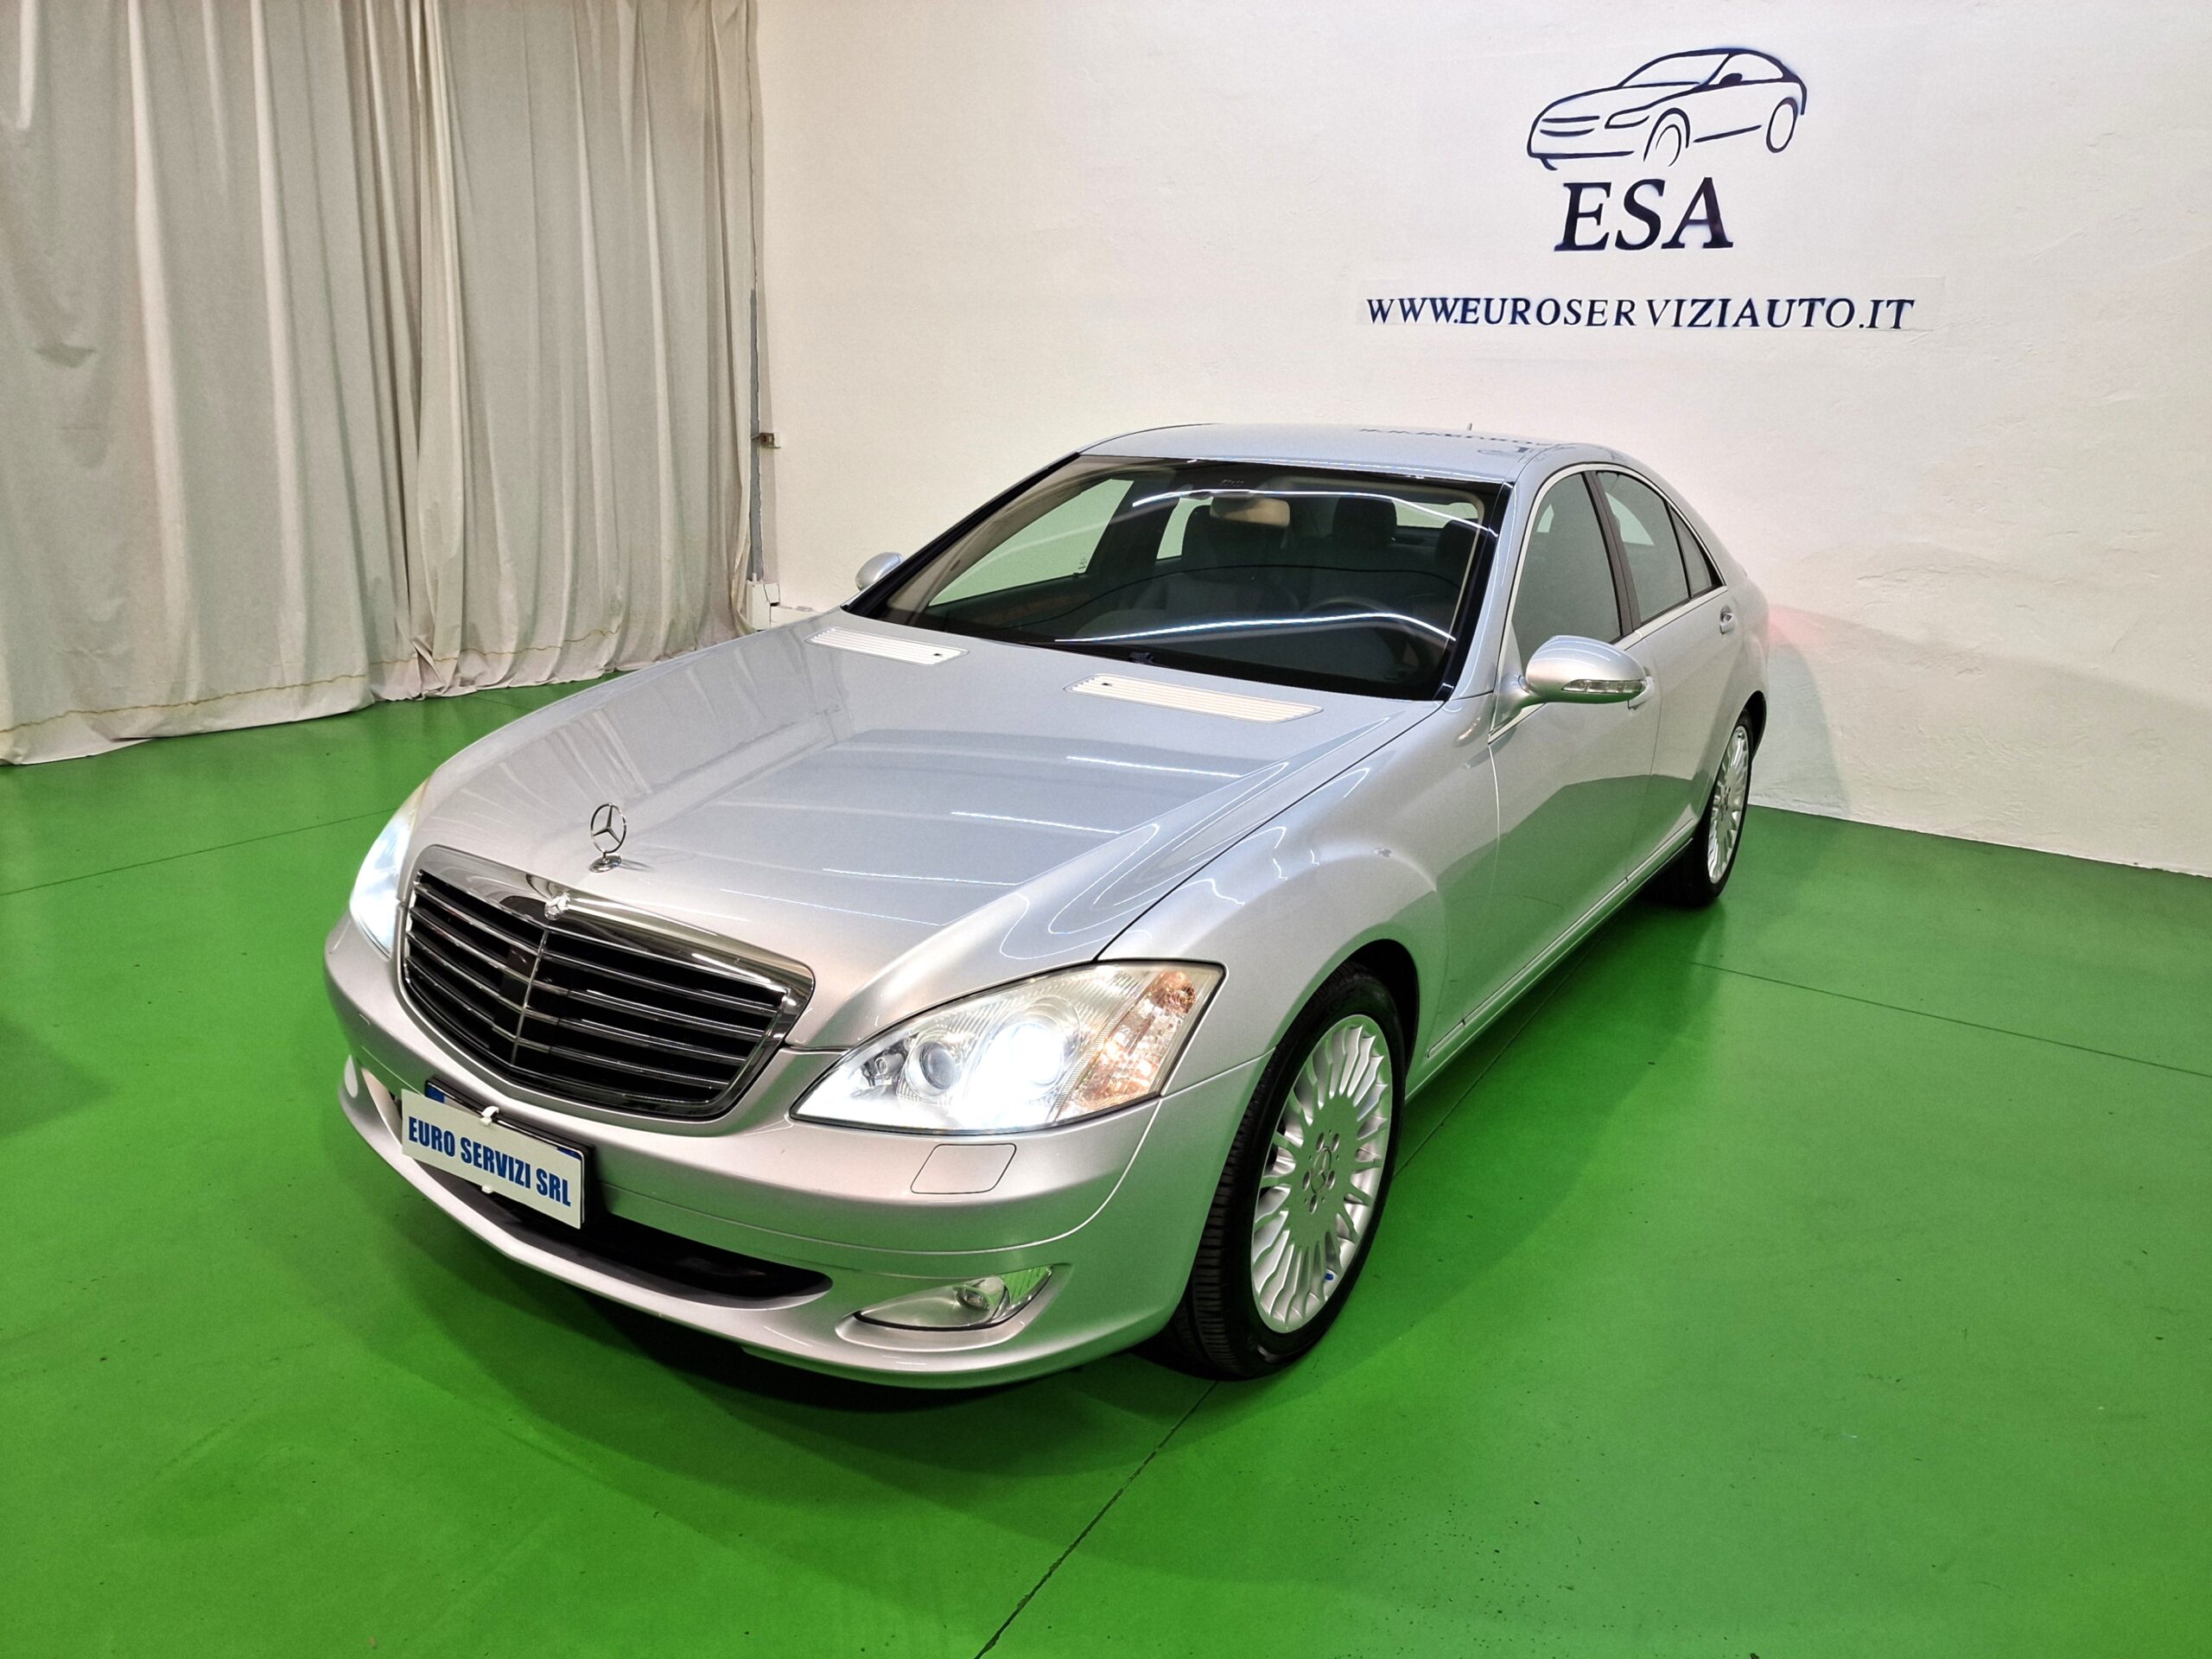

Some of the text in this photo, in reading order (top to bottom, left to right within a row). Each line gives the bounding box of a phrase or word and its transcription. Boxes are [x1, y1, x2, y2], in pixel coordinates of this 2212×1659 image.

[1554, 176, 1734, 252] ESA
[409, 1116, 571, 1207] EURO SERVIZI SRL
